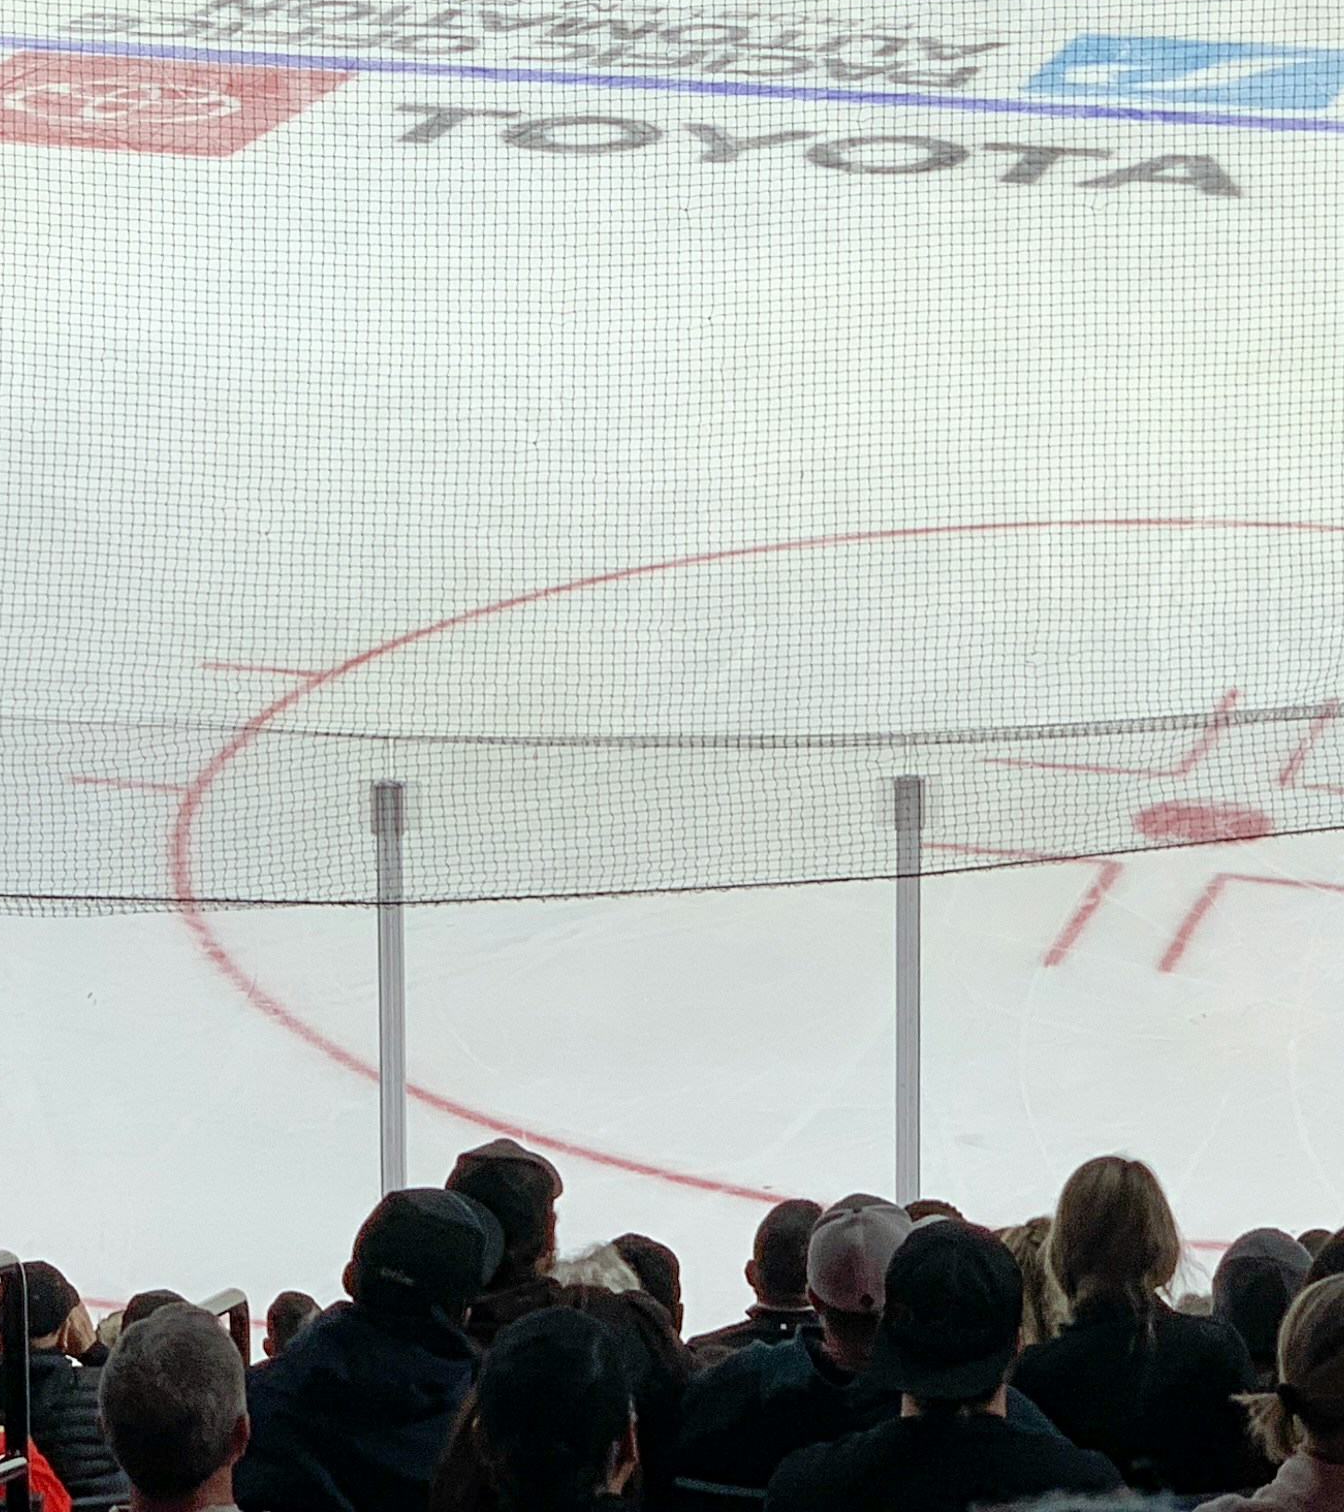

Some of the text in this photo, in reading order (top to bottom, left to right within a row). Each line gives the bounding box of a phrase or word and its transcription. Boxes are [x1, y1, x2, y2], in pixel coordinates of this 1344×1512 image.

[58, 13, 980, 89] PACIFIC OFFICE
[391, 102, 1245, 198] TOYOTA
